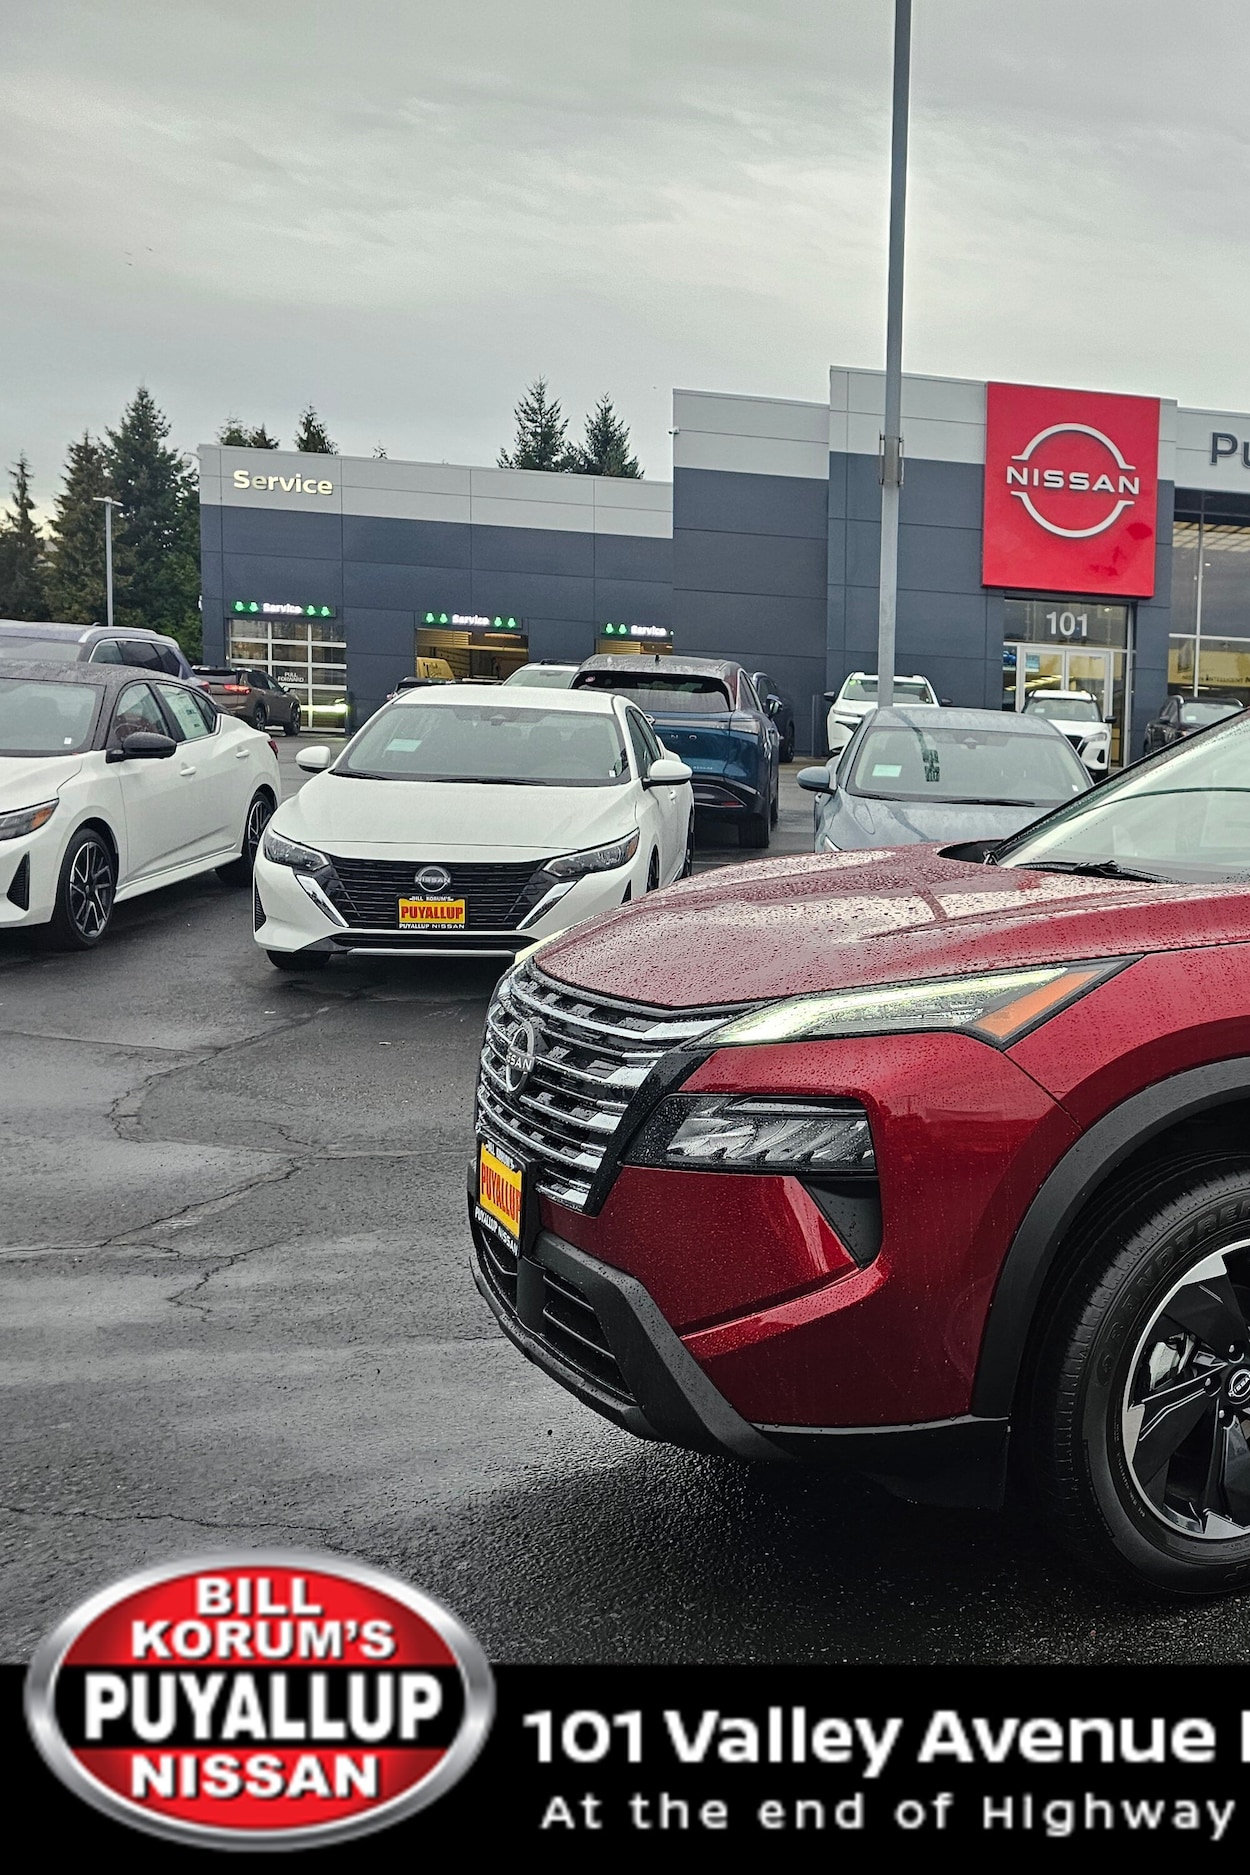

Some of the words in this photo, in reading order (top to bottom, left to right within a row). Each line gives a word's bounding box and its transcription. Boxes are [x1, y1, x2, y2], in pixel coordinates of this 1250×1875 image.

[233, 469, 333, 496] Service
[1006, 465, 1140, 496] NISSAN
[262, 602, 304, 614] Service
[452, 614, 491, 626] Service
[630, 625, 668, 637] Service
[1046, 611, 1089, 637] 101
[401, 906, 463, 919] PUYALLUP
[481, 1161, 521, 1224] PUYALLUP
[498, 1225, 519, 1257] NISSAN
